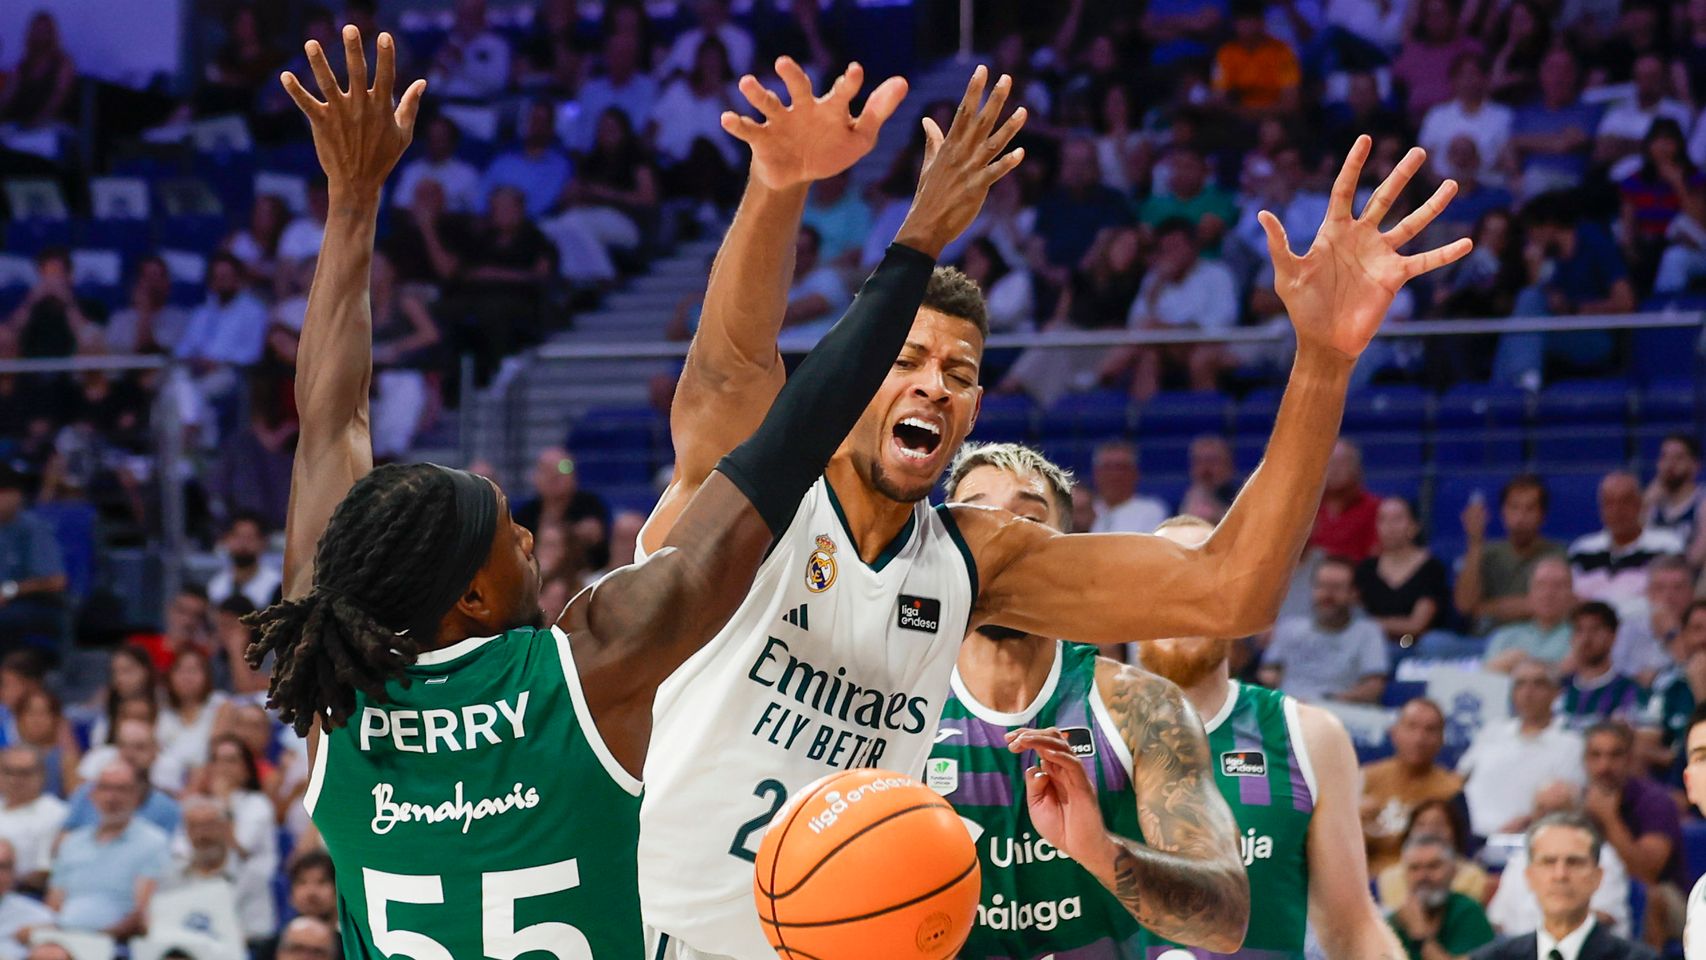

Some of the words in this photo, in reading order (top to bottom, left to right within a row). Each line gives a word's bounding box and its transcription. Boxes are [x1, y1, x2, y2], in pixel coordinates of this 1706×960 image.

[901, 604, 919, 617] liga
[901, 617, 937, 629] endesa
[748, 635, 928, 735] Emiraes
[360, 690, 530, 753] PERRY
[752, 701, 811, 750] FLY
[728, 778, 789, 864] 2
[807, 799, 849, 834] liga
[362, 857, 594, 960] 55
